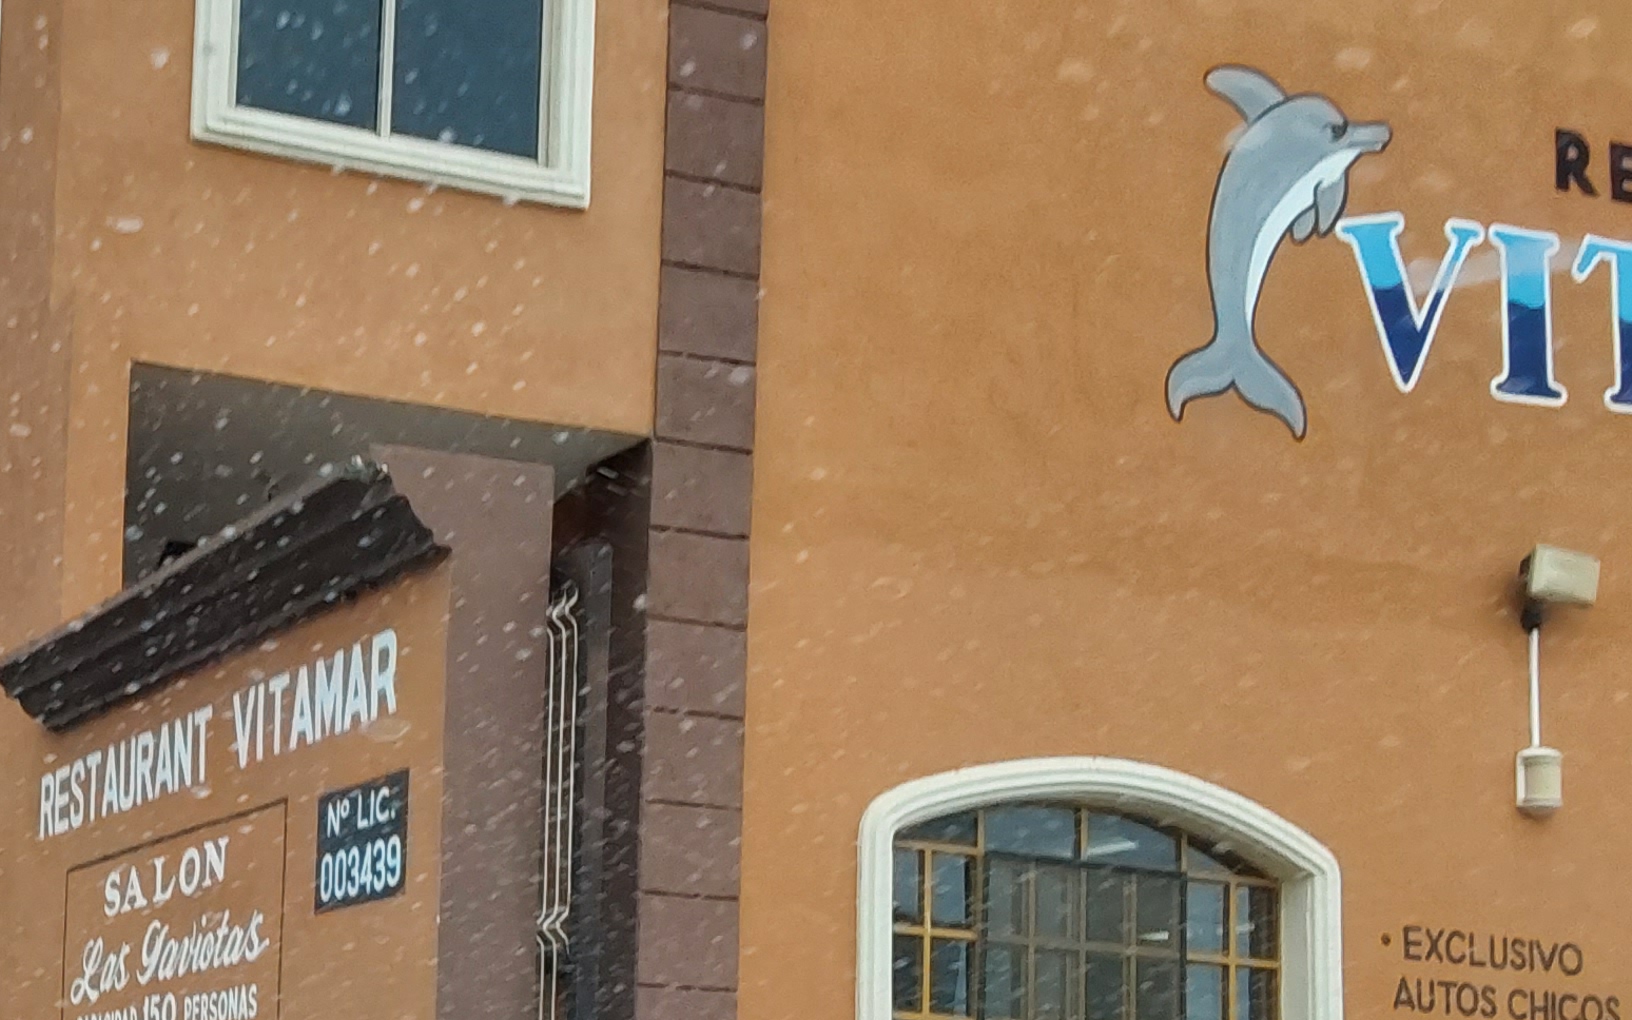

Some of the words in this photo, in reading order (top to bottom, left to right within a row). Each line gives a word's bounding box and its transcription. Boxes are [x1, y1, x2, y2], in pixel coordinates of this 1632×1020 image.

[39, 704, 213, 841] RESTAURANT
[233, 628, 398, 769] VITAMAR
[357, 786, 396, 830] LIC.
[103, 836, 229, 917] SALON
[320, 834, 402, 903] 003439
[70, 935, 131, 1005] Las
[136, 908, 270, 985] Gaviotas
[1402, 924, 1583, 977] EXCLUSIVO
[1393, 976, 1498, 1019] AUTOS
